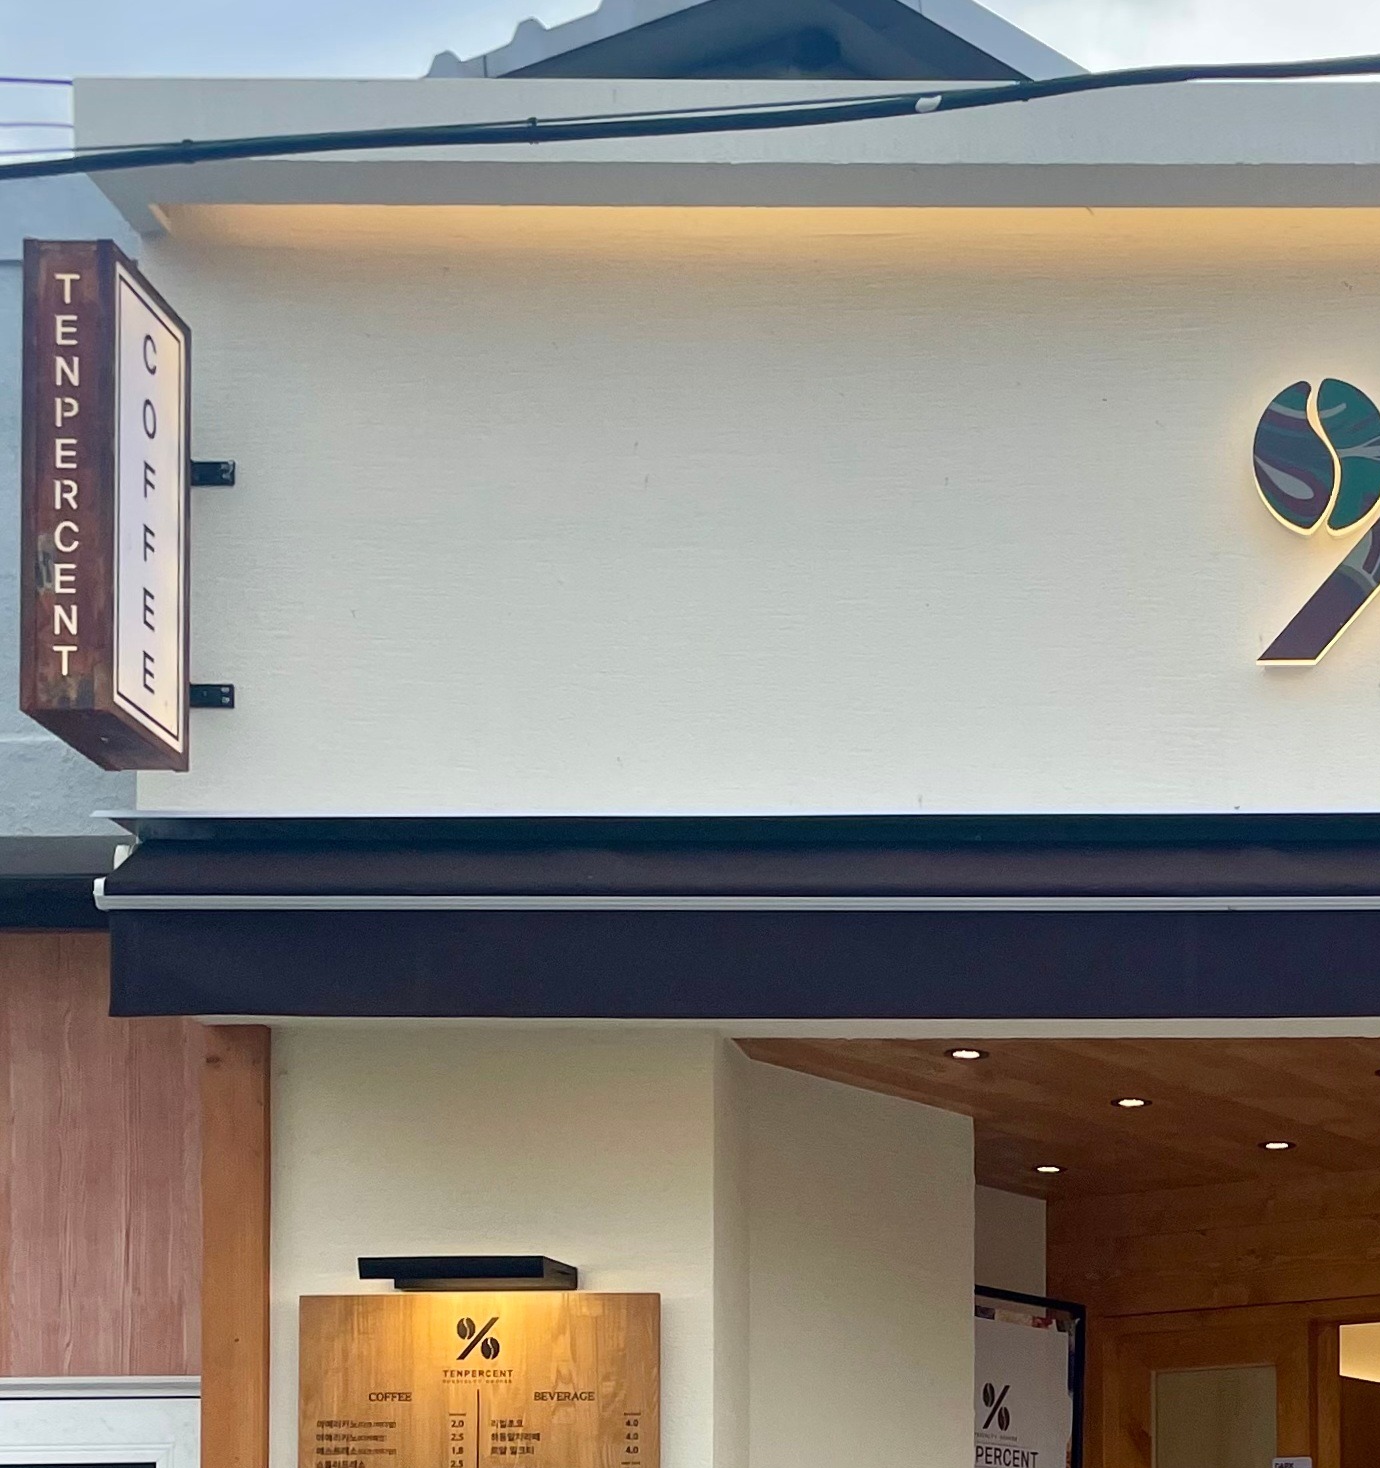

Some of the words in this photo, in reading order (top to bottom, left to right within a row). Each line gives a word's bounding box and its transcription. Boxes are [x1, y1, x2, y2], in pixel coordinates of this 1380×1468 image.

[52, 272, 81, 677] TENPERCENT
[141, 334, 157, 695] COFFEE
[442, 1368, 514, 1379] TENPERCENT
[368, 1392, 413, 1403] COFFEE
[533, 1391, 595, 1402] BEVERAGE
[450, 1420, 465, 1428] 2.0
[625, 1419, 640, 1428] 4.0
[450, 1433, 465, 1442] 2.5
[625, 1432, 640, 1441] 4.0
[625, 1446, 640, 1455] 4.0
[450, 1460, 465, 1468] 2.5
